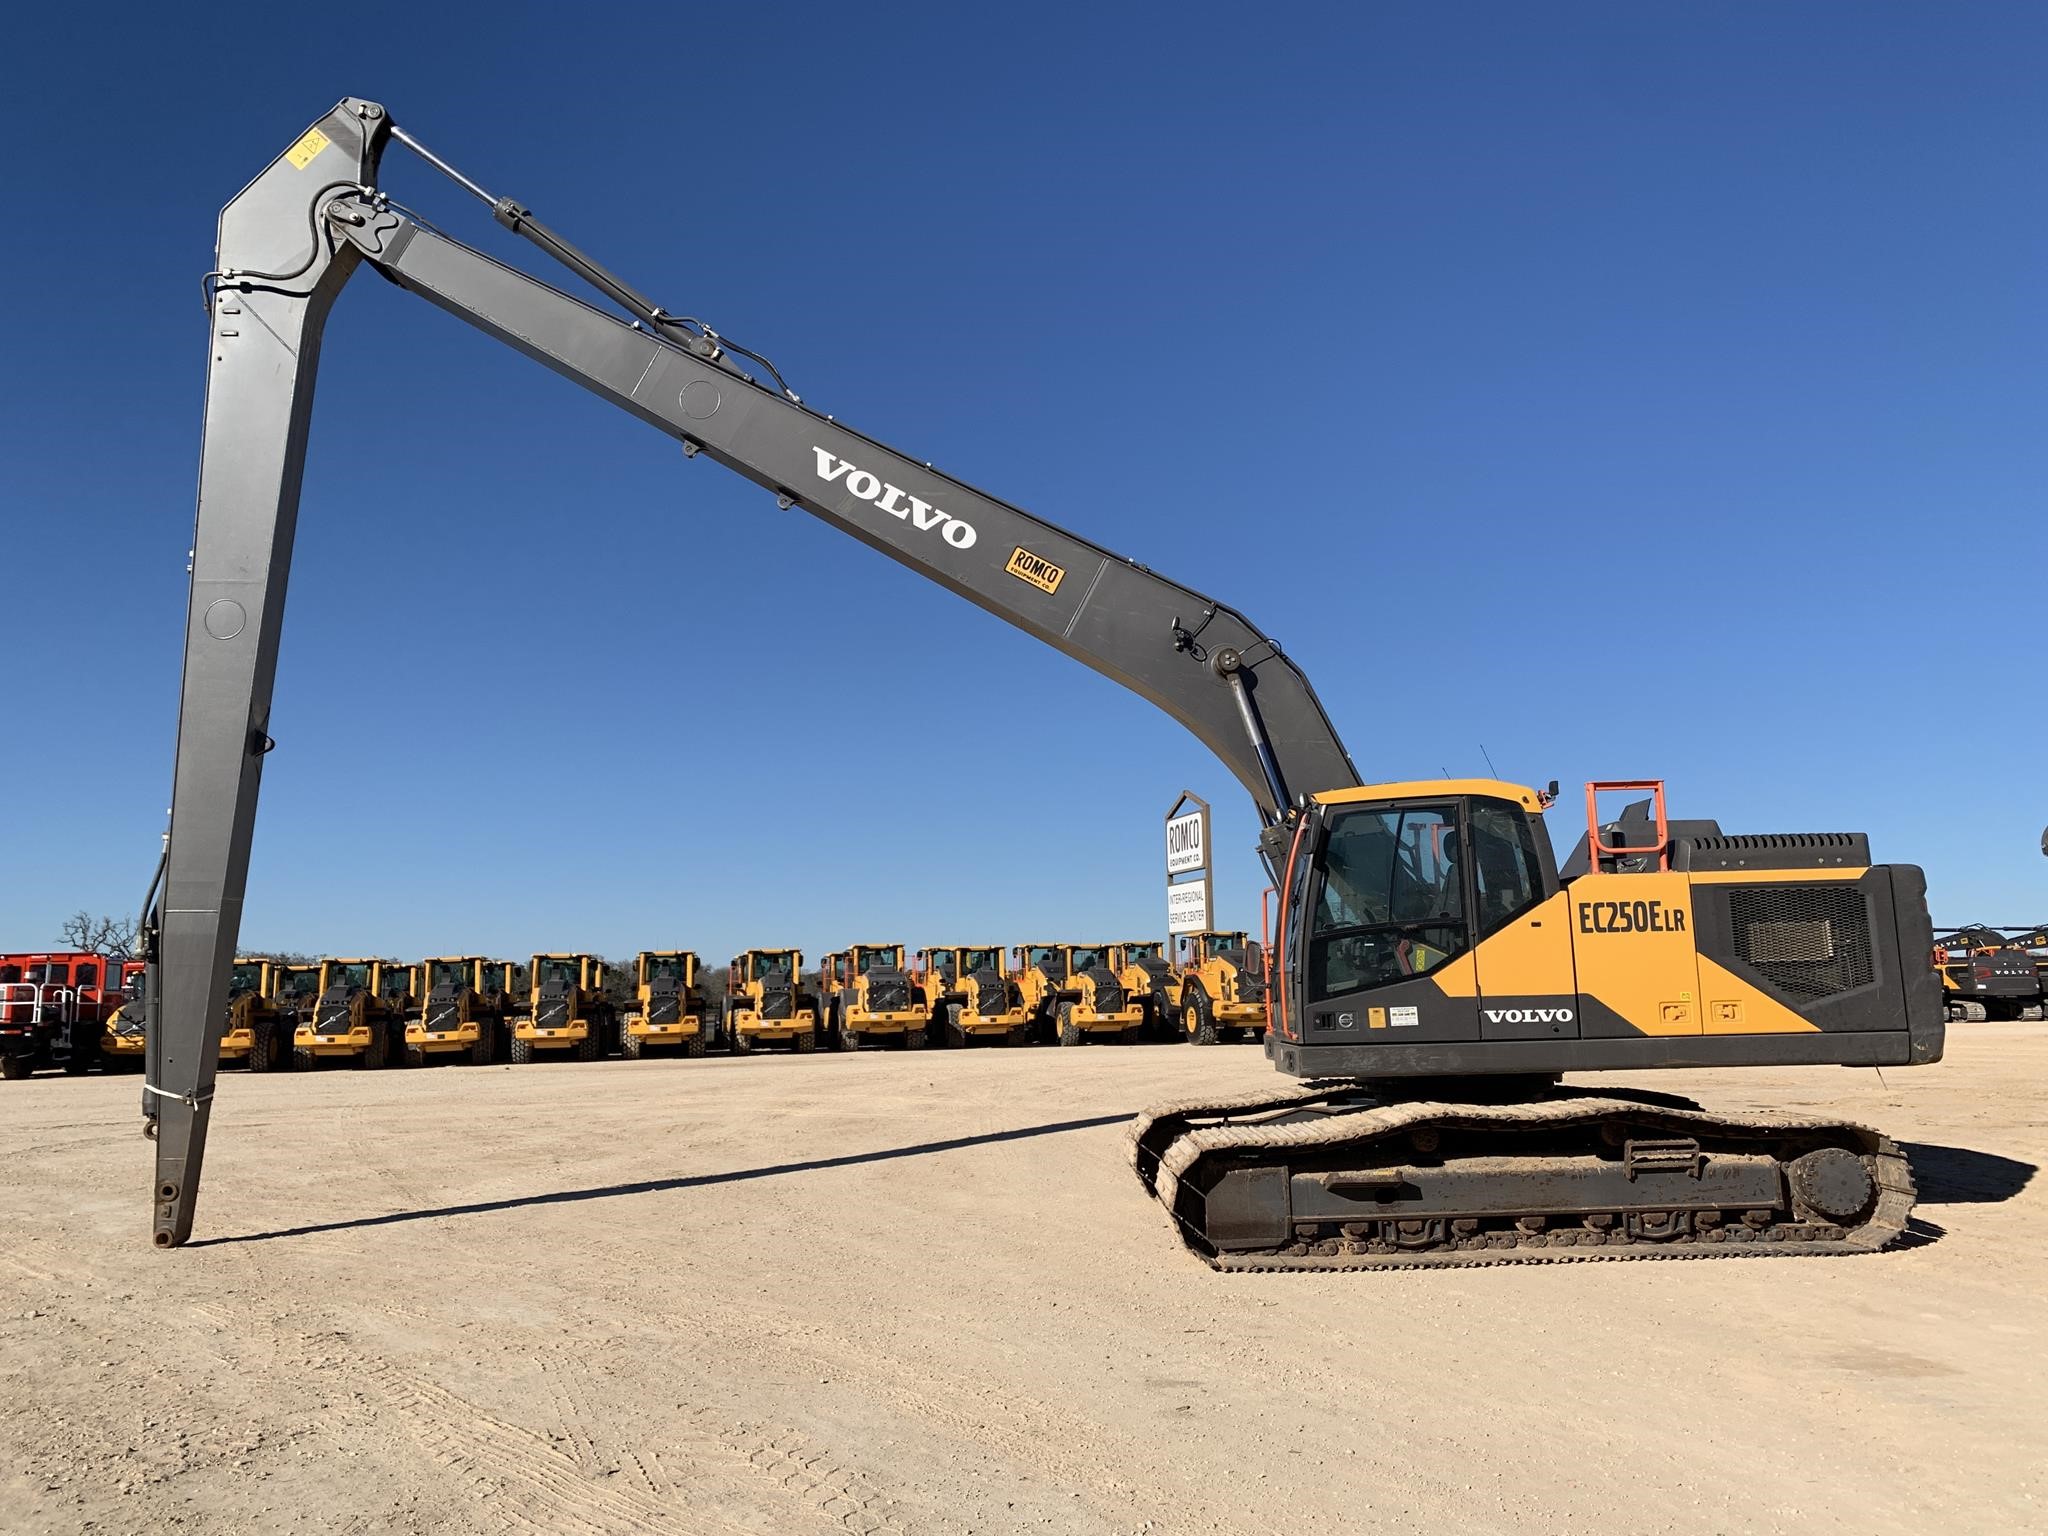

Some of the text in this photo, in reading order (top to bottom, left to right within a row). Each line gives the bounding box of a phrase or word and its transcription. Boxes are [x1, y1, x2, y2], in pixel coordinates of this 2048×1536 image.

[812, 446, 977, 549] VOLVO
[1010, 567, 1041, 585] EQUIPMENT
[1014, 551, 1059, 583] ROMCO
[1169, 819, 1200, 854] ROMCO
[1169, 854, 1193, 866] EQUIPMENT
[1170, 910, 1204, 924] SERVICE CENTER
[1484, 1008, 1573, 1023] VOLVO
